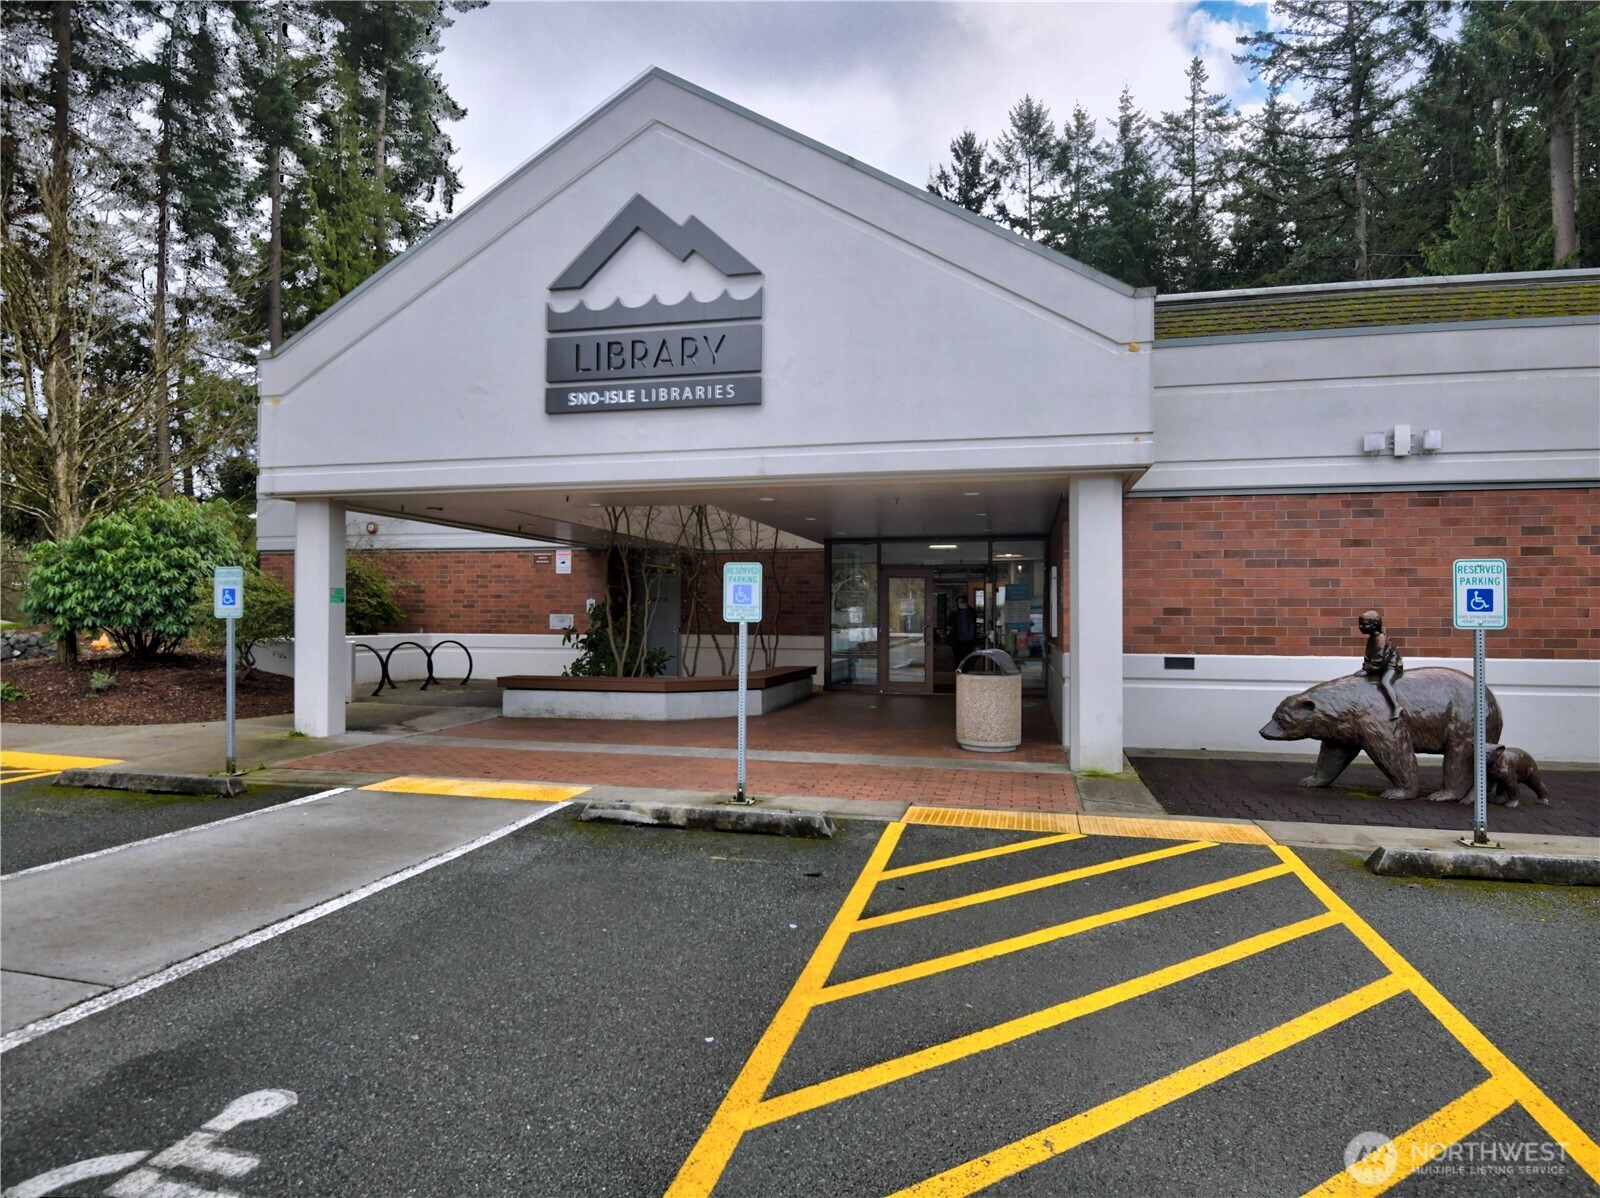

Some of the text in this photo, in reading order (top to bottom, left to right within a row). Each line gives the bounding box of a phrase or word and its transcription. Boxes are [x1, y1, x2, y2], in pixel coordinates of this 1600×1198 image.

[575, 334, 726, 372] LIBRARY
[567, 384, 736, 406] SNO-ISLE LIBRARIES
[1457, 565, 1503, 574] RESERVED
[728, 575, 758, 584] PARKING
[1459, 577, 1501, 586] PARKING
